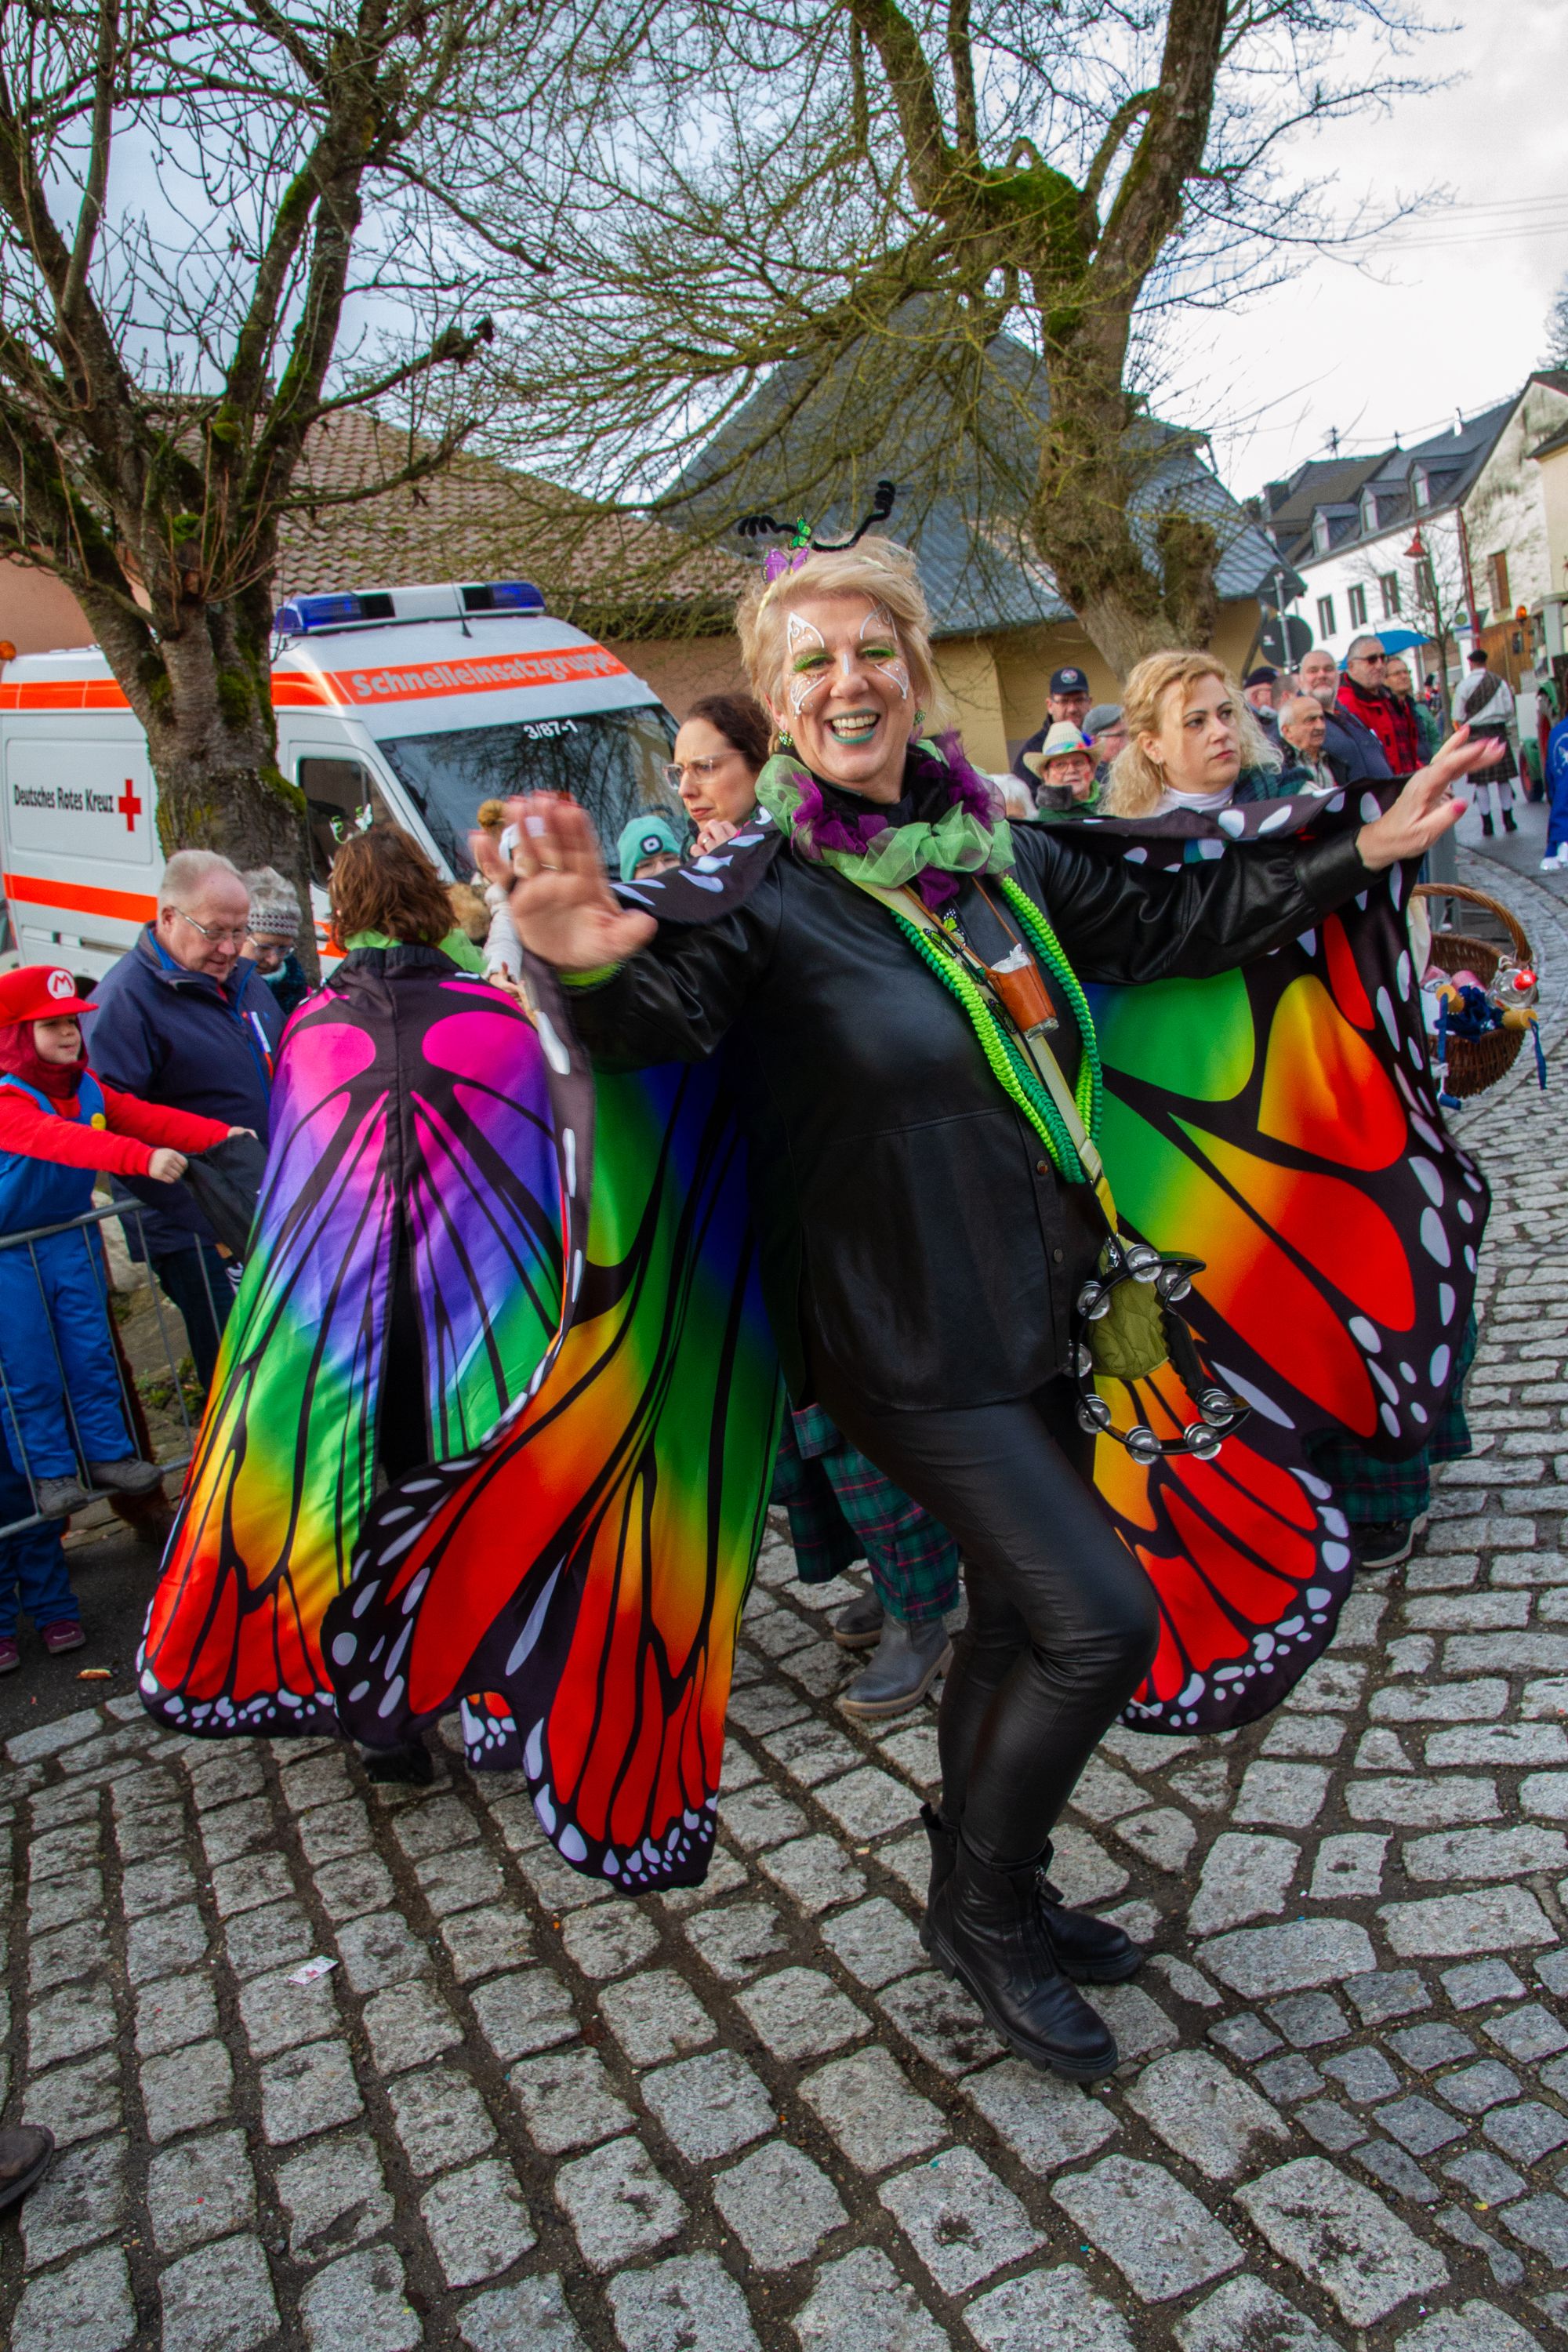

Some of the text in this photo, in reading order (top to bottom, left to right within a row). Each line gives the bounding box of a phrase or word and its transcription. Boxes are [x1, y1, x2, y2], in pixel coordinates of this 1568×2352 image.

[524, 719, 578, 740] 3/87-1
[13, 785, 114, 813] Deutsches Rotes Kreuz
[53, 974, 73, 993] M
